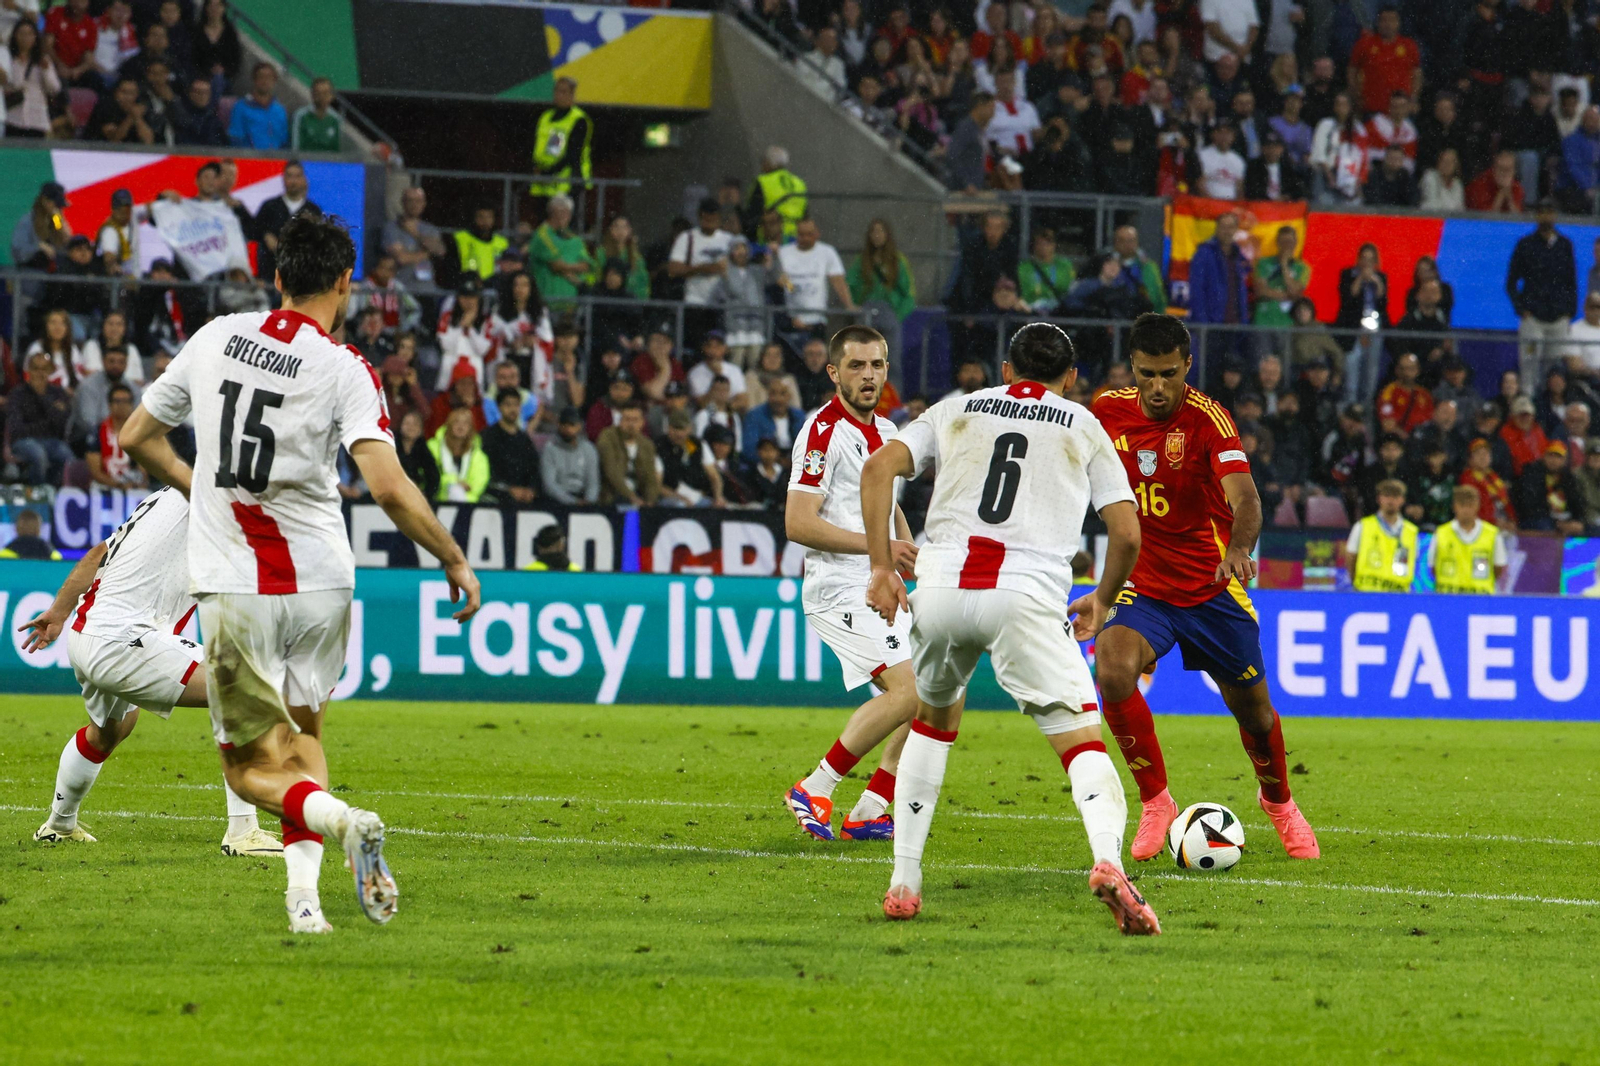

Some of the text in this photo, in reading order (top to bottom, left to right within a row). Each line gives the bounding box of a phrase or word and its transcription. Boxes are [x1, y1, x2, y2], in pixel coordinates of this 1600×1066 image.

[223, 334, 303, 380] GVELESIANI
[215, 379, 285, 494] 15
[963, 398, 1075, 429] KOCHORASHVILI
[977, 431, 1029, 525] 6
[1134, 481, 1171, 518] 16
[418, 580, 646, 704] Easy
[667, 576, 824, 682] livi
